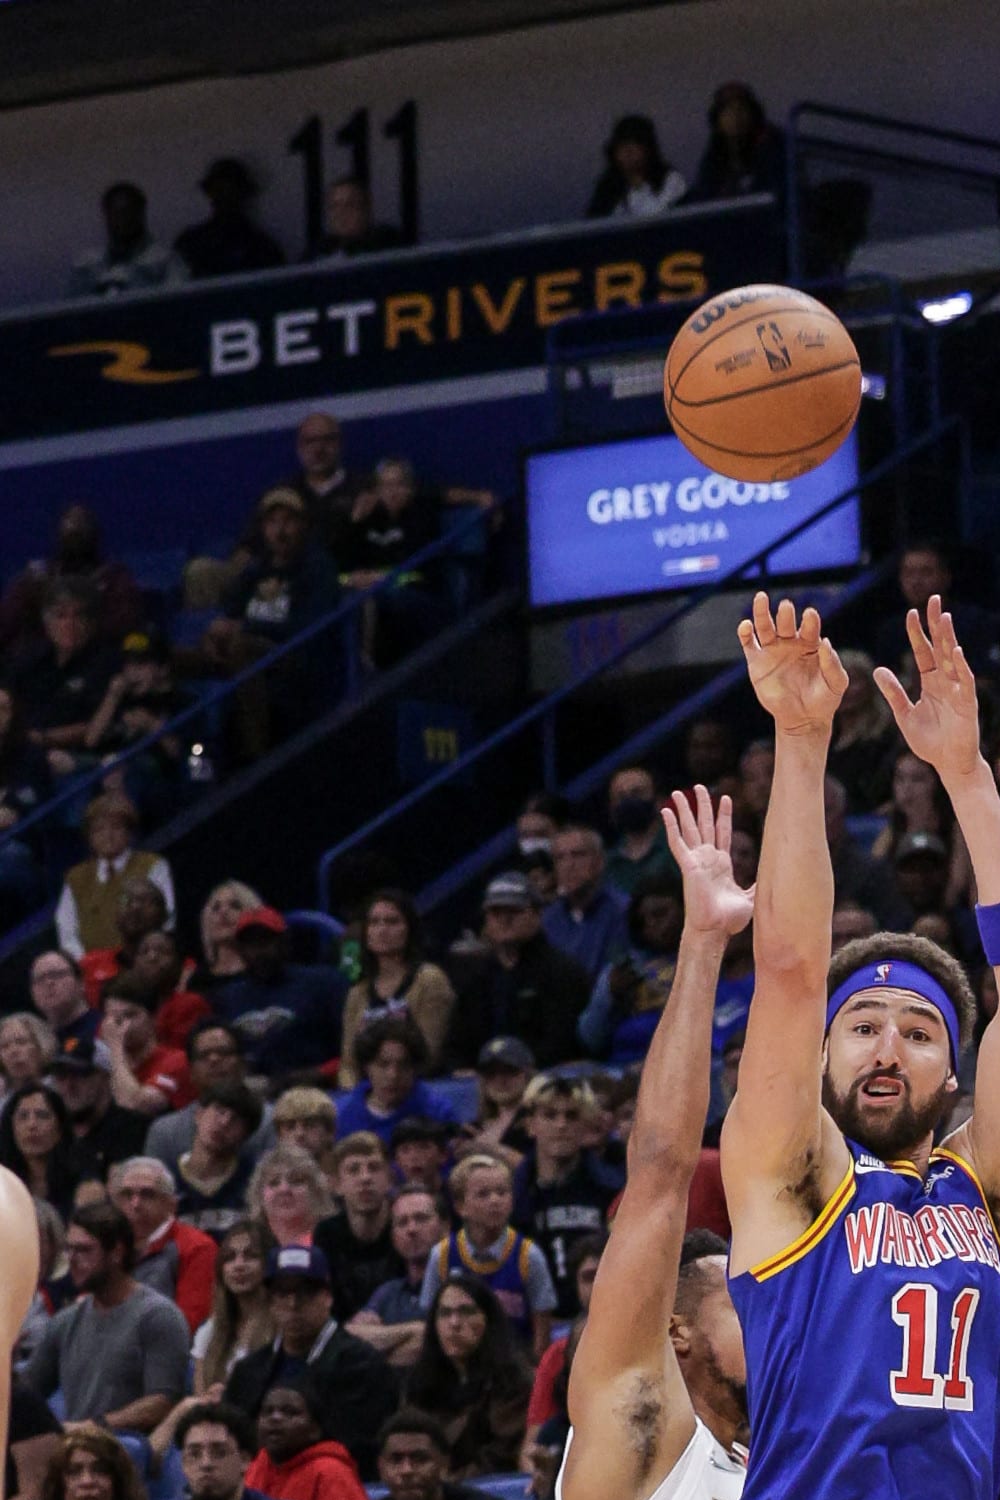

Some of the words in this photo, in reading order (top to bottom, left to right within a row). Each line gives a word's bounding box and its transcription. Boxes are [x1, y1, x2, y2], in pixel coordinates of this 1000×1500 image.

[288, 99, 419, 255] 111
[587, 481, 671, 524] GREY
[890, 1282, 980, 1412] 11
